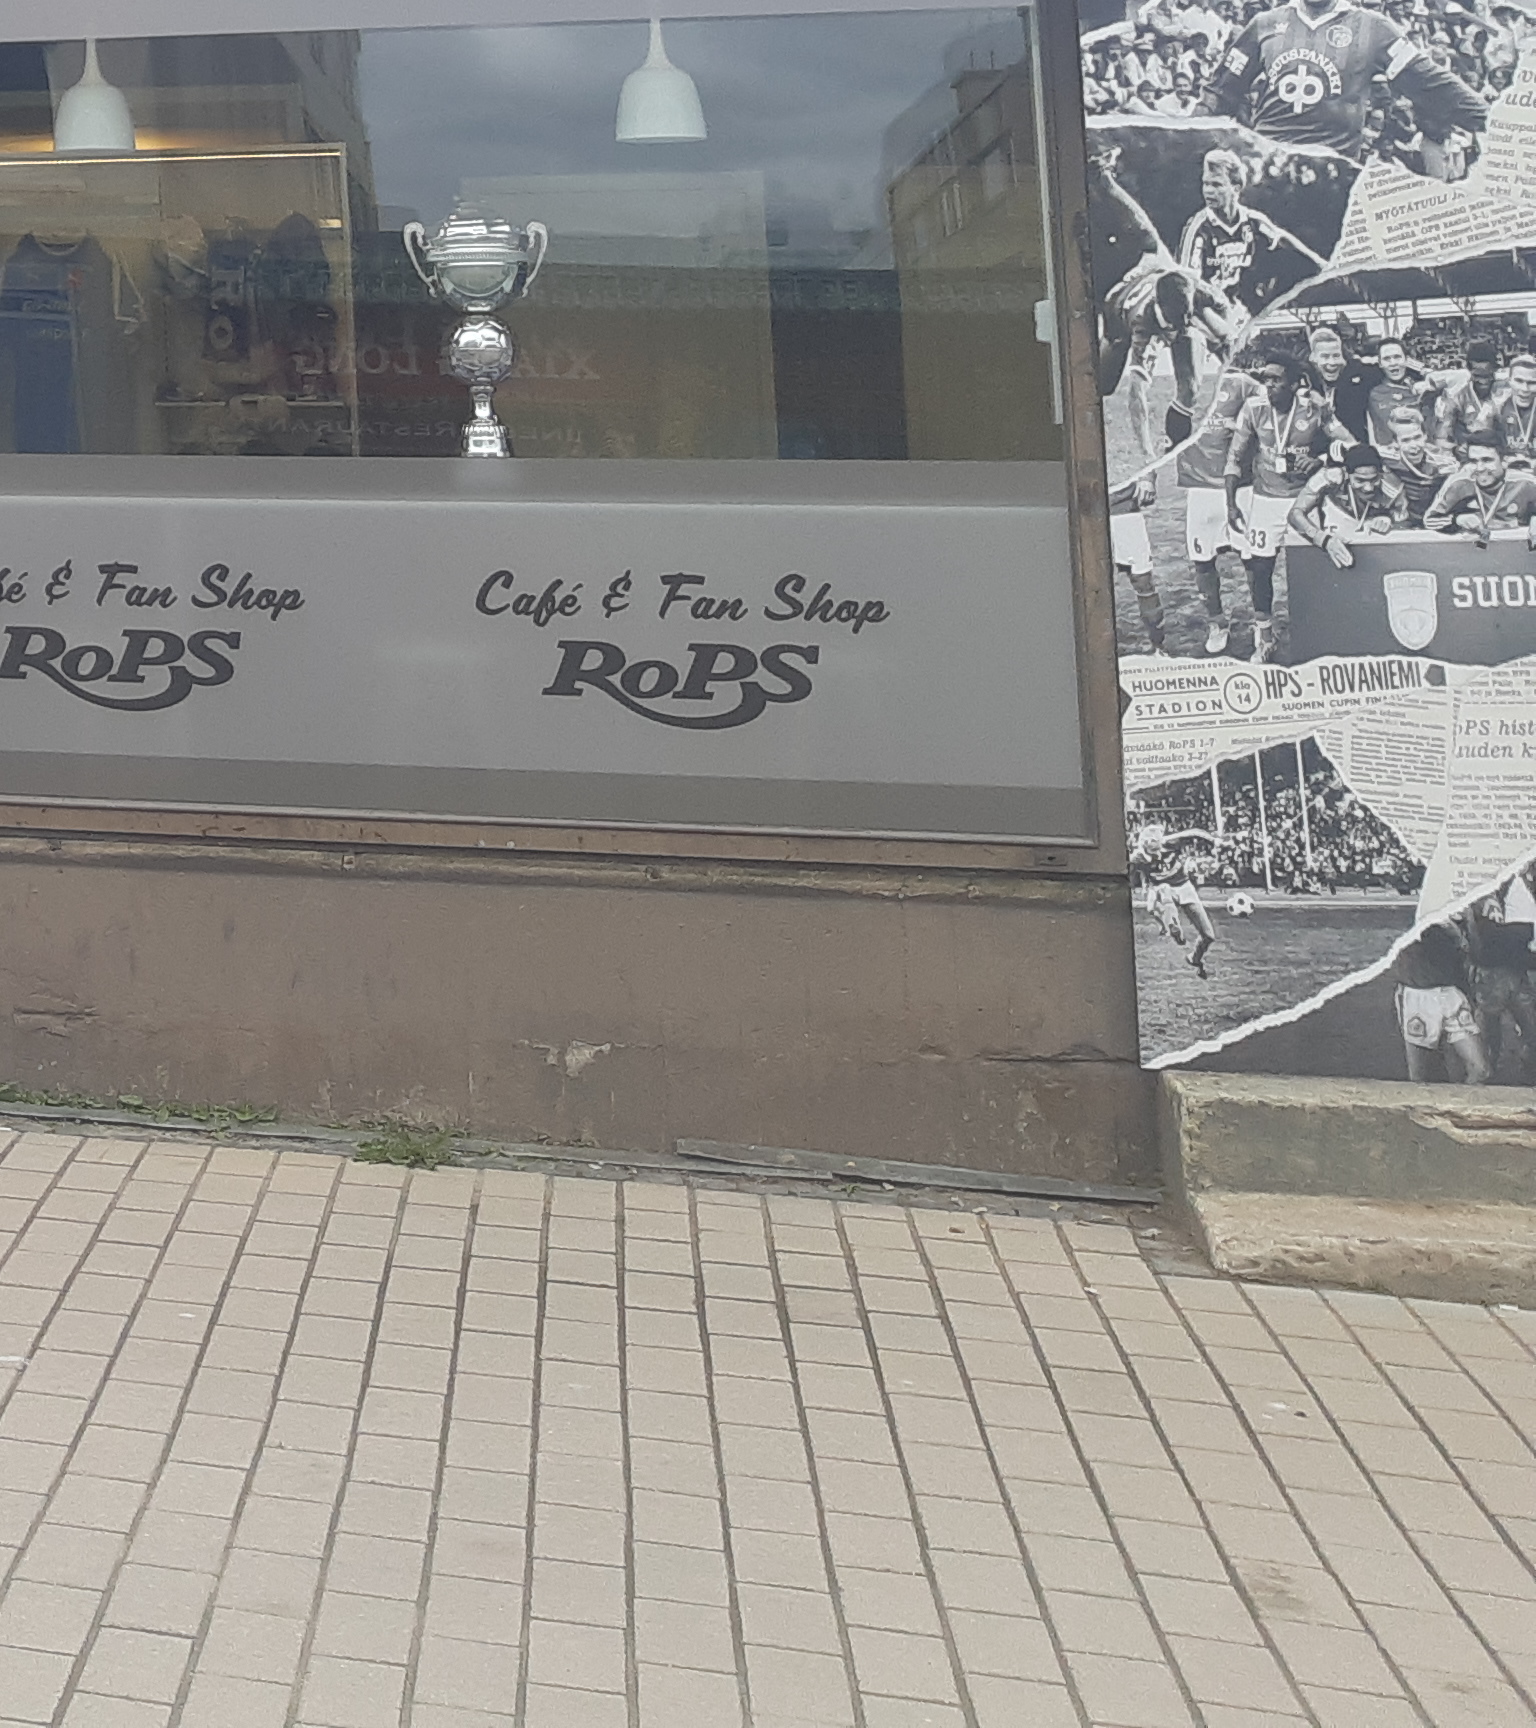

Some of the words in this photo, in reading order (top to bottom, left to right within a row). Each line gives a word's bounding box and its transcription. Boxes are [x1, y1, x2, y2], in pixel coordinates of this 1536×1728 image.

[96, 562, 178, 612] Fan
[192, 564, 305, 616] Shop
[476, 569, 582, 624] Café
[658, 572, 747, 624] Fan
[763, 574, 890, 630] Shop
[541, 640, 819, 731] RoPS
[1132, 675, 1220, 693] HUOMENNA
[1263, 668, 1302, 700] HPS
[1319, 660, 1422, 696] ROVANIEMI
[1134, 699, 1224, 717] STADION
[1236, 692, 1252, 705] 14
[1282, 701, 1325, 711] SUOMEN
